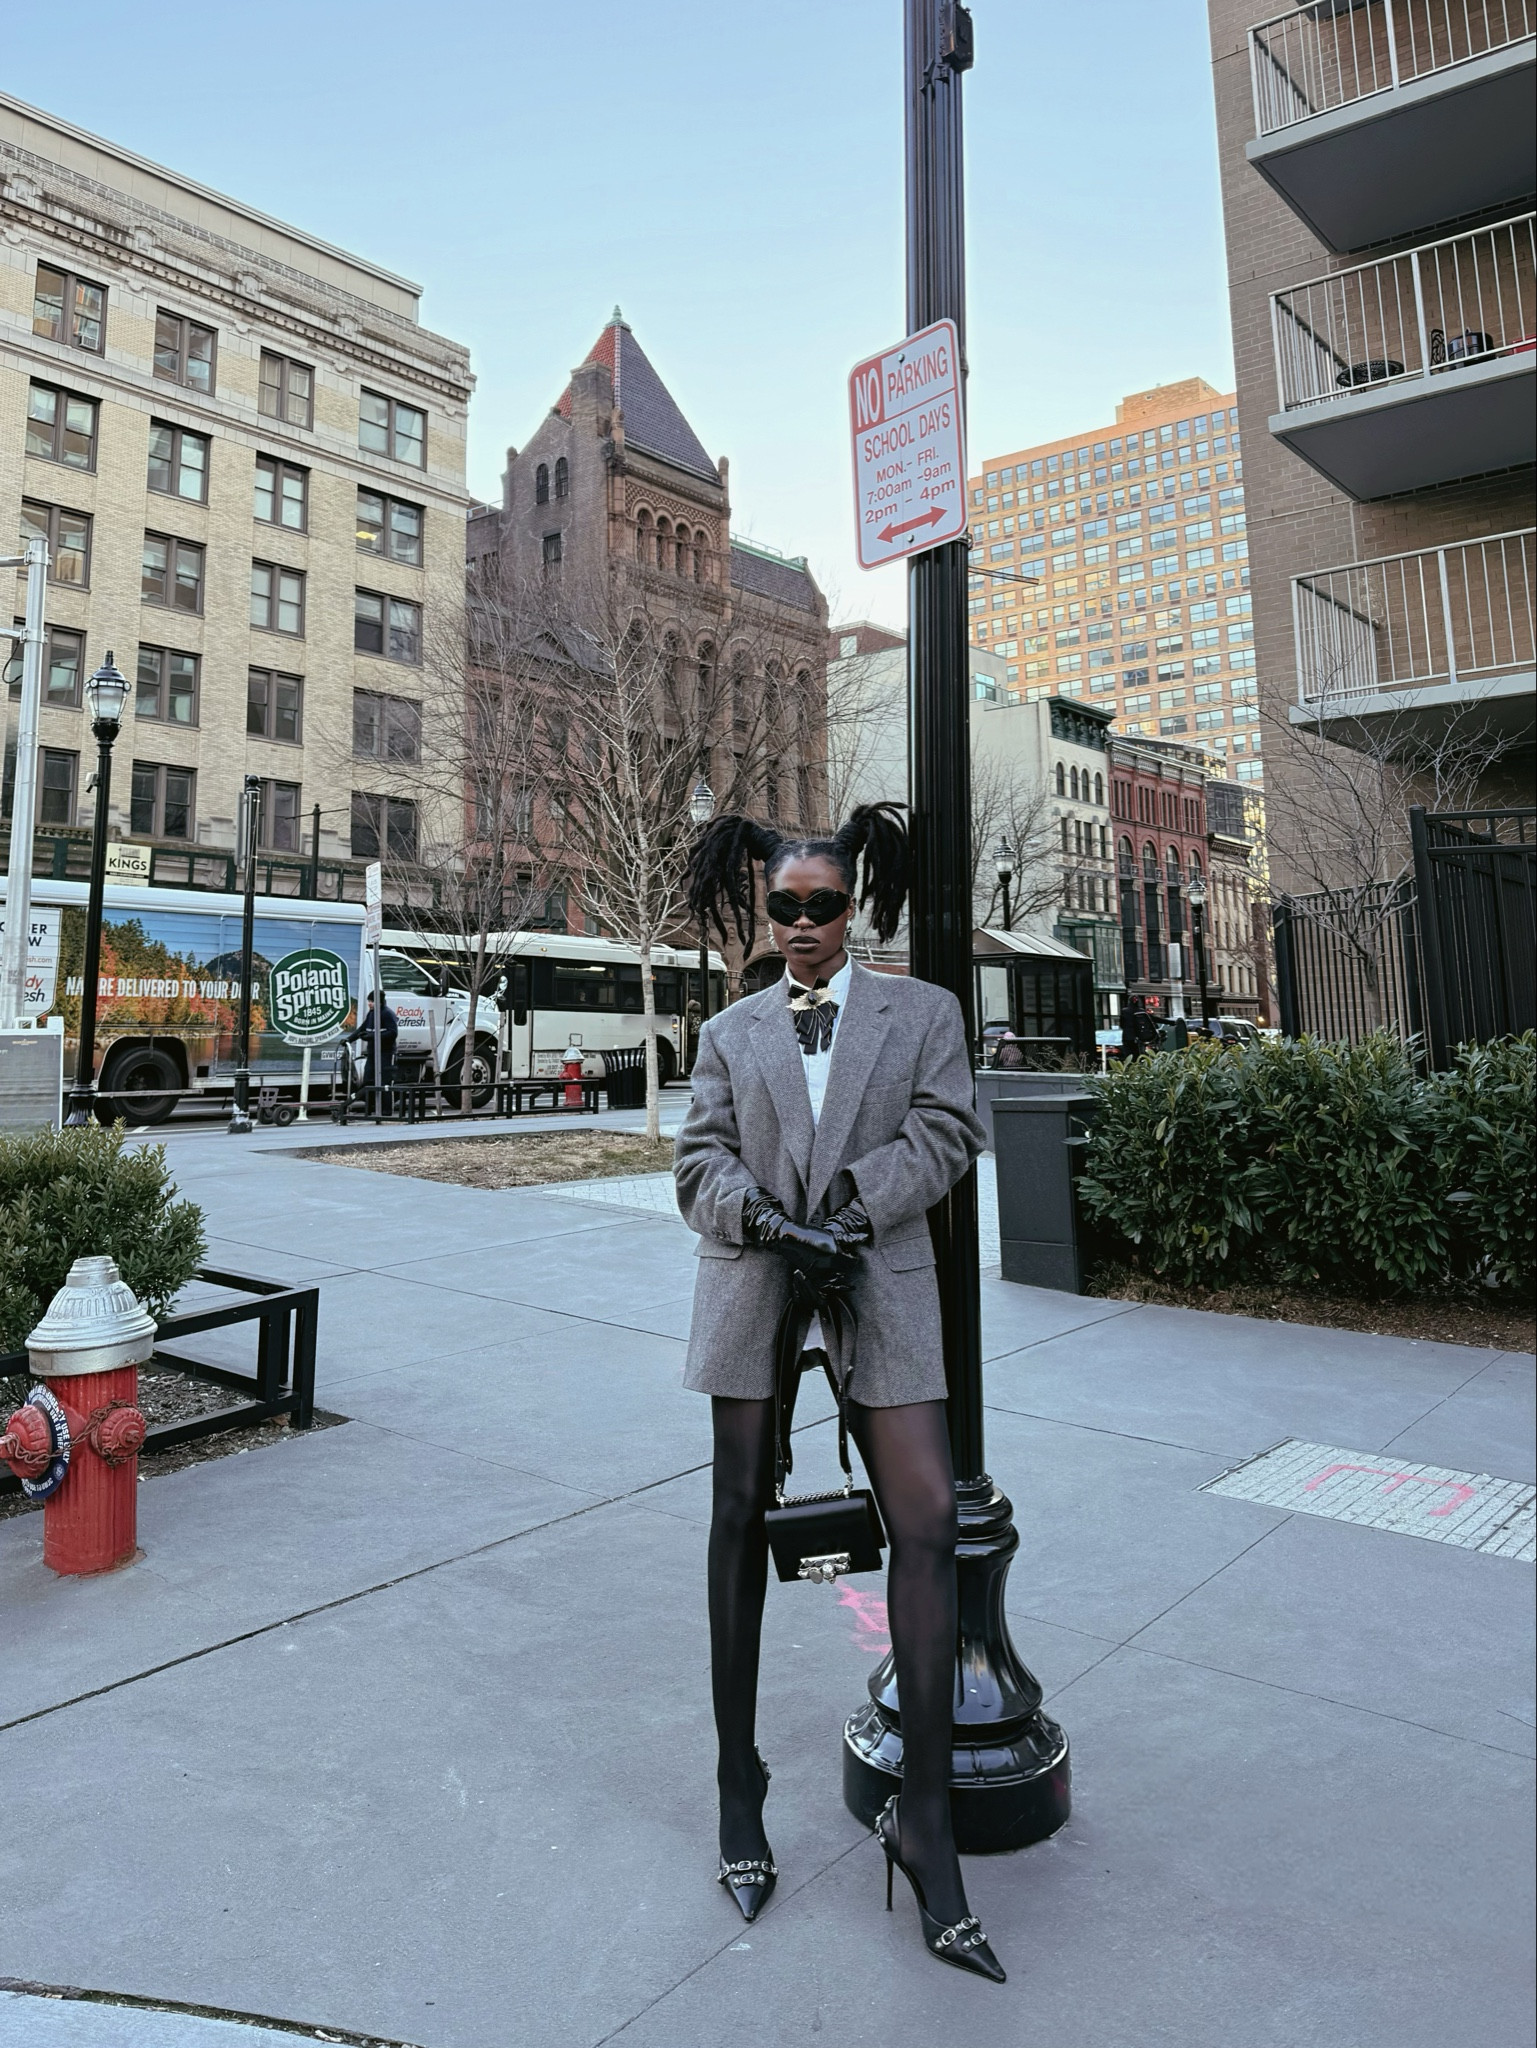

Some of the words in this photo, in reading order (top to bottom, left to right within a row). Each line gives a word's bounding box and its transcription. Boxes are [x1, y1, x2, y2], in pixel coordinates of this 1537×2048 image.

[855, 367, 881, 428] NO
[887, 346, 949, 402] PARKING
[864, 421, 915, 463] SCHOOL
[919, 403, 950, 438] DAYS
[917, 446, 940, 466] FRI.
[865, 503, 898, 524] 2pm
[919, 479, 955, 500] 4pm
[867, 479, 912, 504] 7:00am
[108, 857, 148, 871] KINGS
[66, 976, 114, 997] NARE
[117, 978, 179, 998] DELIVERED
[182, 980, 196, 998] TO
[199, 980, 228, 999] YOUR
[231, 981, 260, 999] DR
[275, 961, 343, 998] Poland
[276, 985, 345, 1021] Spring
[303, 1007, 322, 1018] 1845
[396, 1006, 424, 1018] Ready
[398, 1016, 426, 1027] efresh
